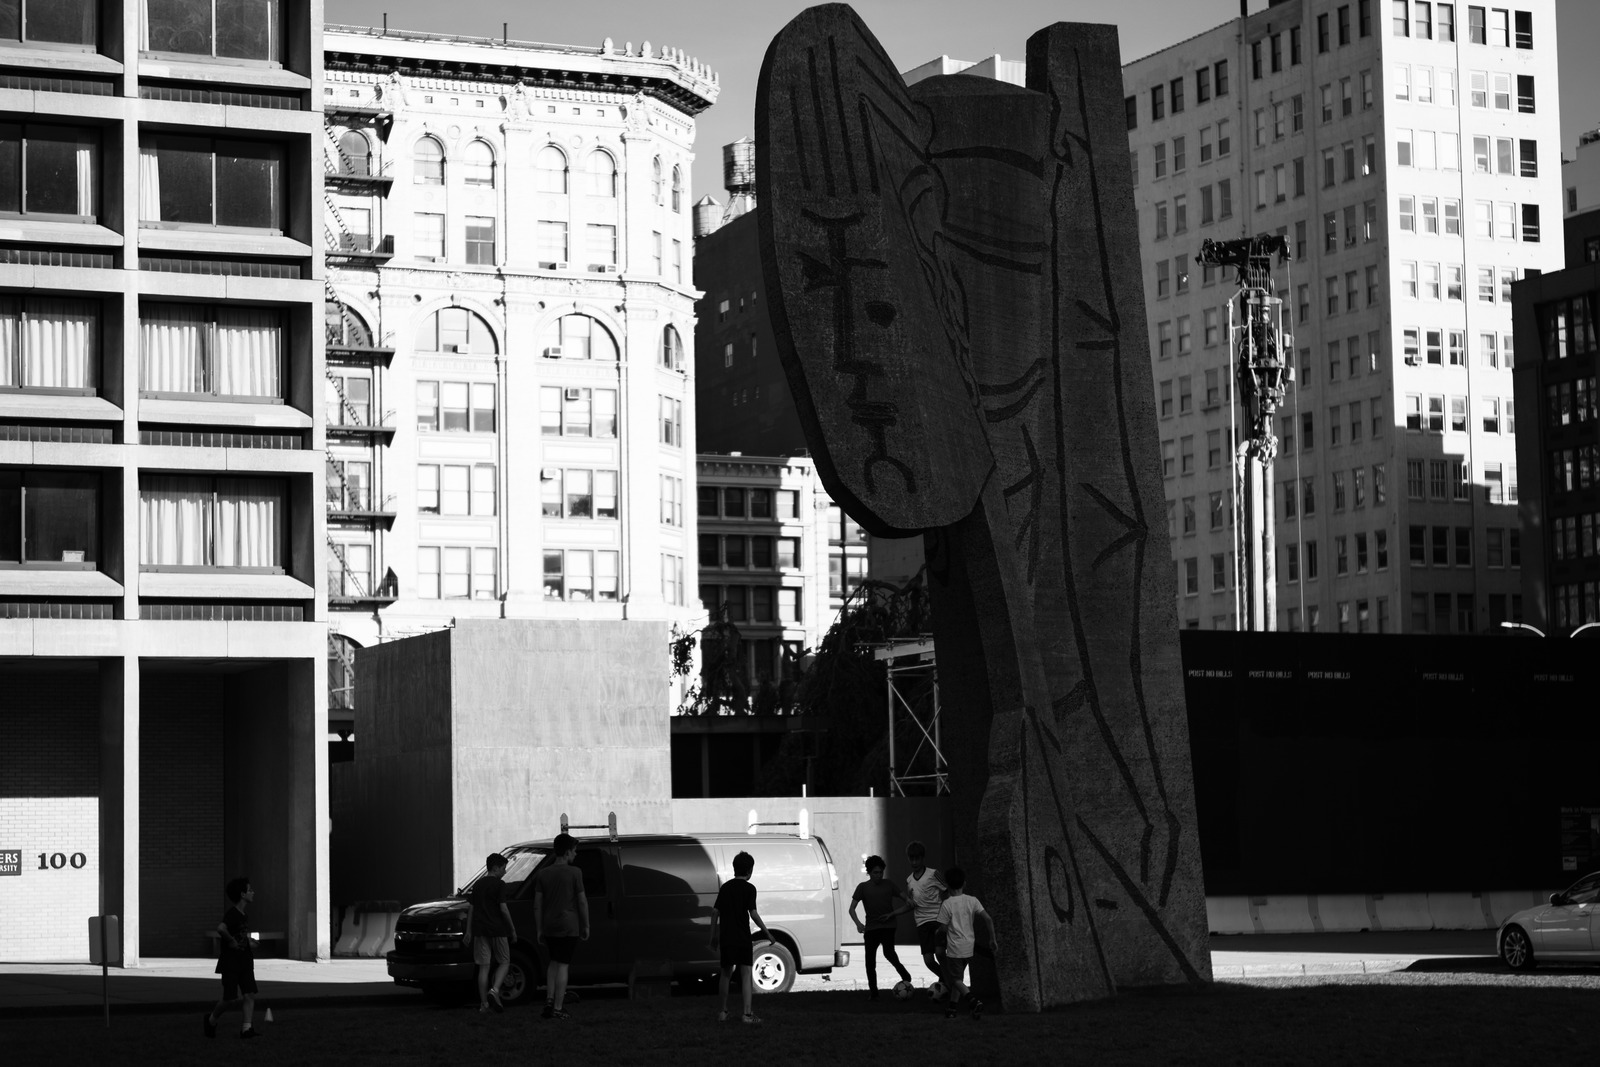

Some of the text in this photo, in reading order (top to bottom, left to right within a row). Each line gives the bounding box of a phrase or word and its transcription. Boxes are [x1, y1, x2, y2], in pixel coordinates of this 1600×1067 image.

[1188, 669, 1233, 678] POST NO BILLS
[1248, 670, 1265, 678] POST
[1307, 671, 1323, 679] POST
[38, 852, 87, 870] 100
